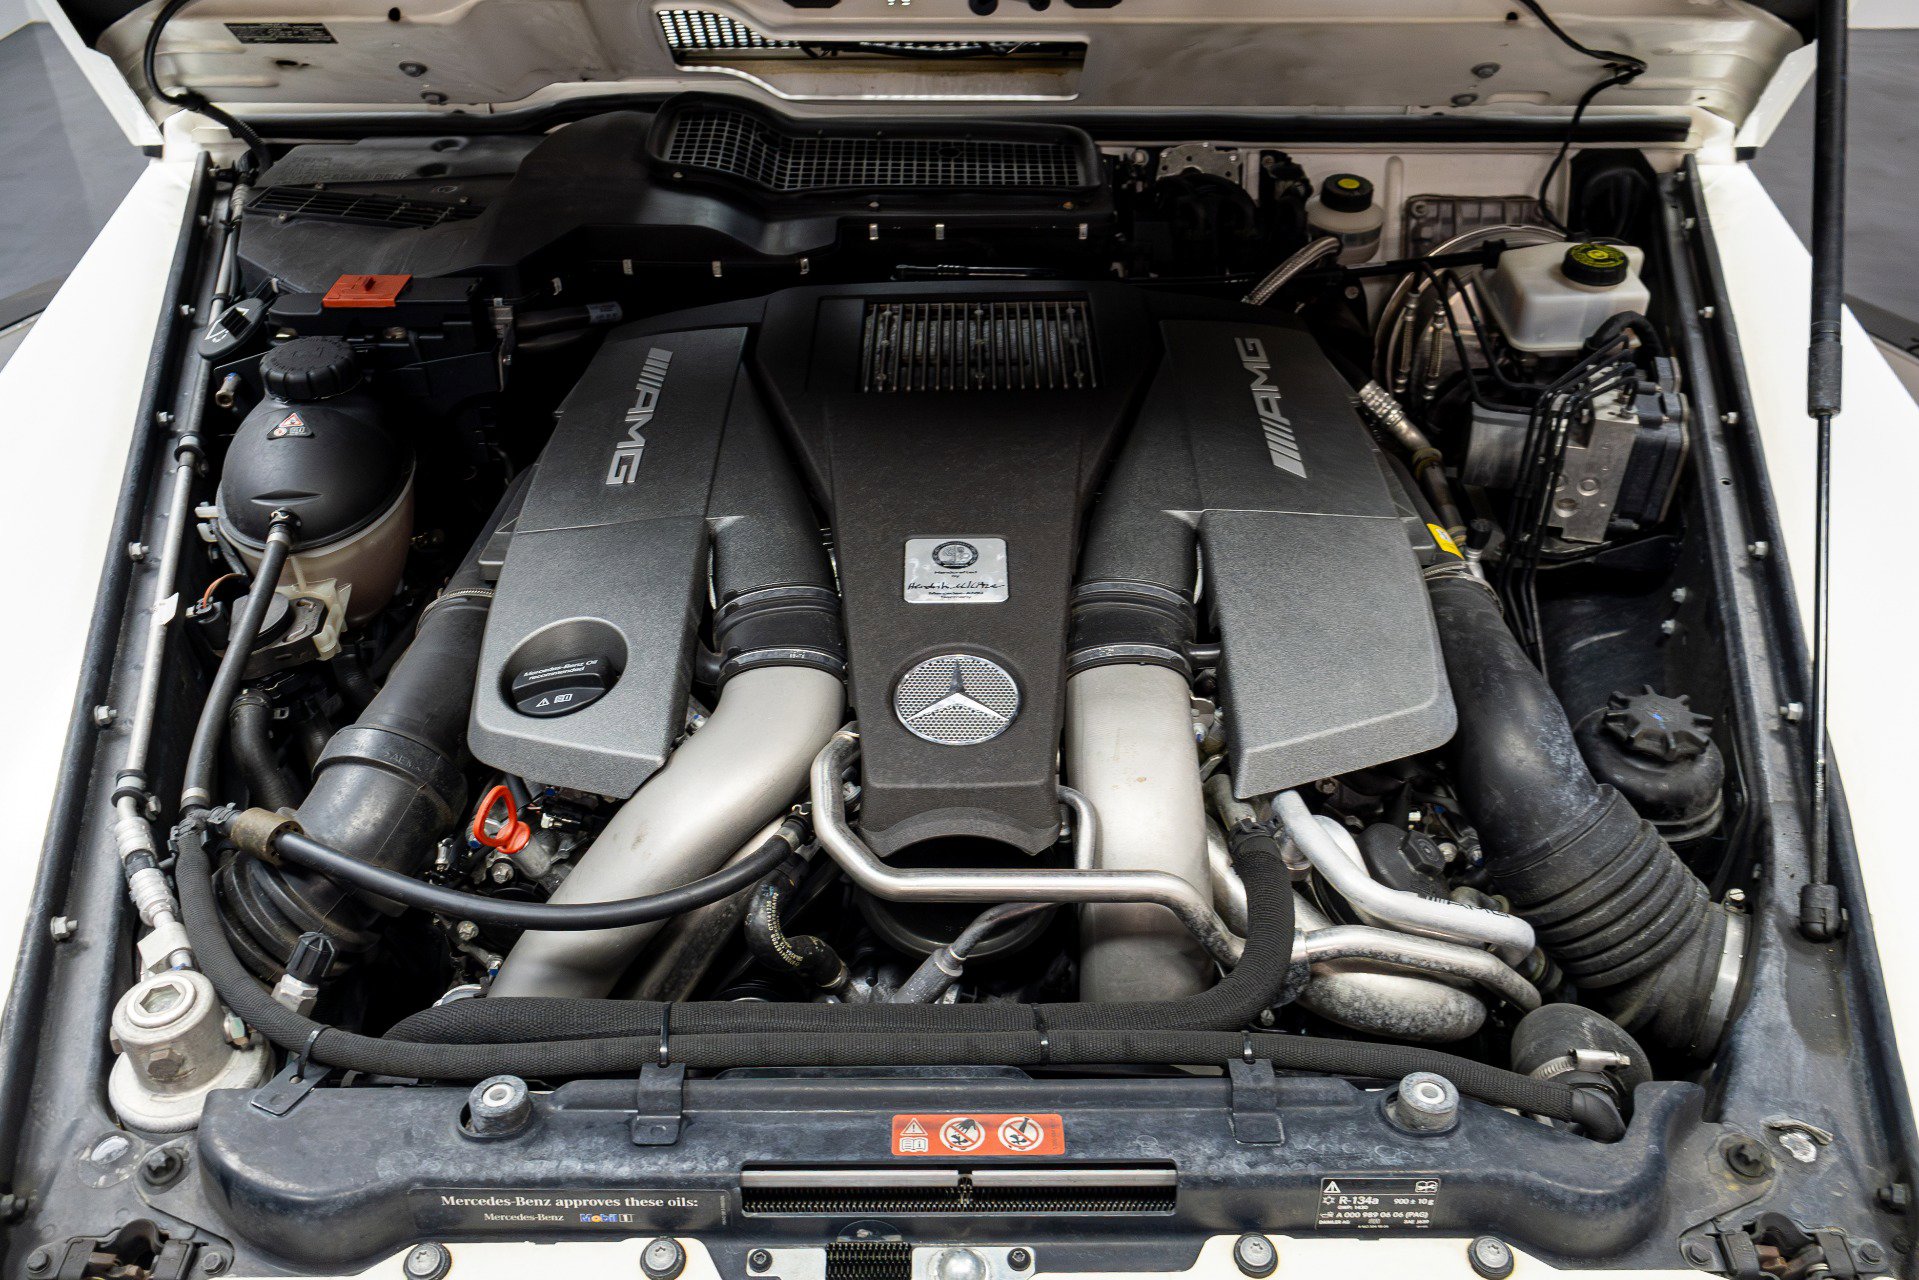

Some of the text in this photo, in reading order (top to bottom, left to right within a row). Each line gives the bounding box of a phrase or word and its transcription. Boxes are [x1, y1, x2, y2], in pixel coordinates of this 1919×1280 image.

[1234, 337, 1291, 426] AMG
[605, 382, 662, 485] AMG
[523, 661, 585, 677] Mercedes-Benz
[528, 666, 586, 680] recommended
[441, 1195, 699, 1208] Mercedes-Benz approves these oils:
[1338, 1196, 1380, 1205] R-134a
[484, 1213, 564, 1221] Mercedes-Benz
[580, 1213, 618, 1223] Mobil
[1405, 1211, 1429, 1219] (PAG)
